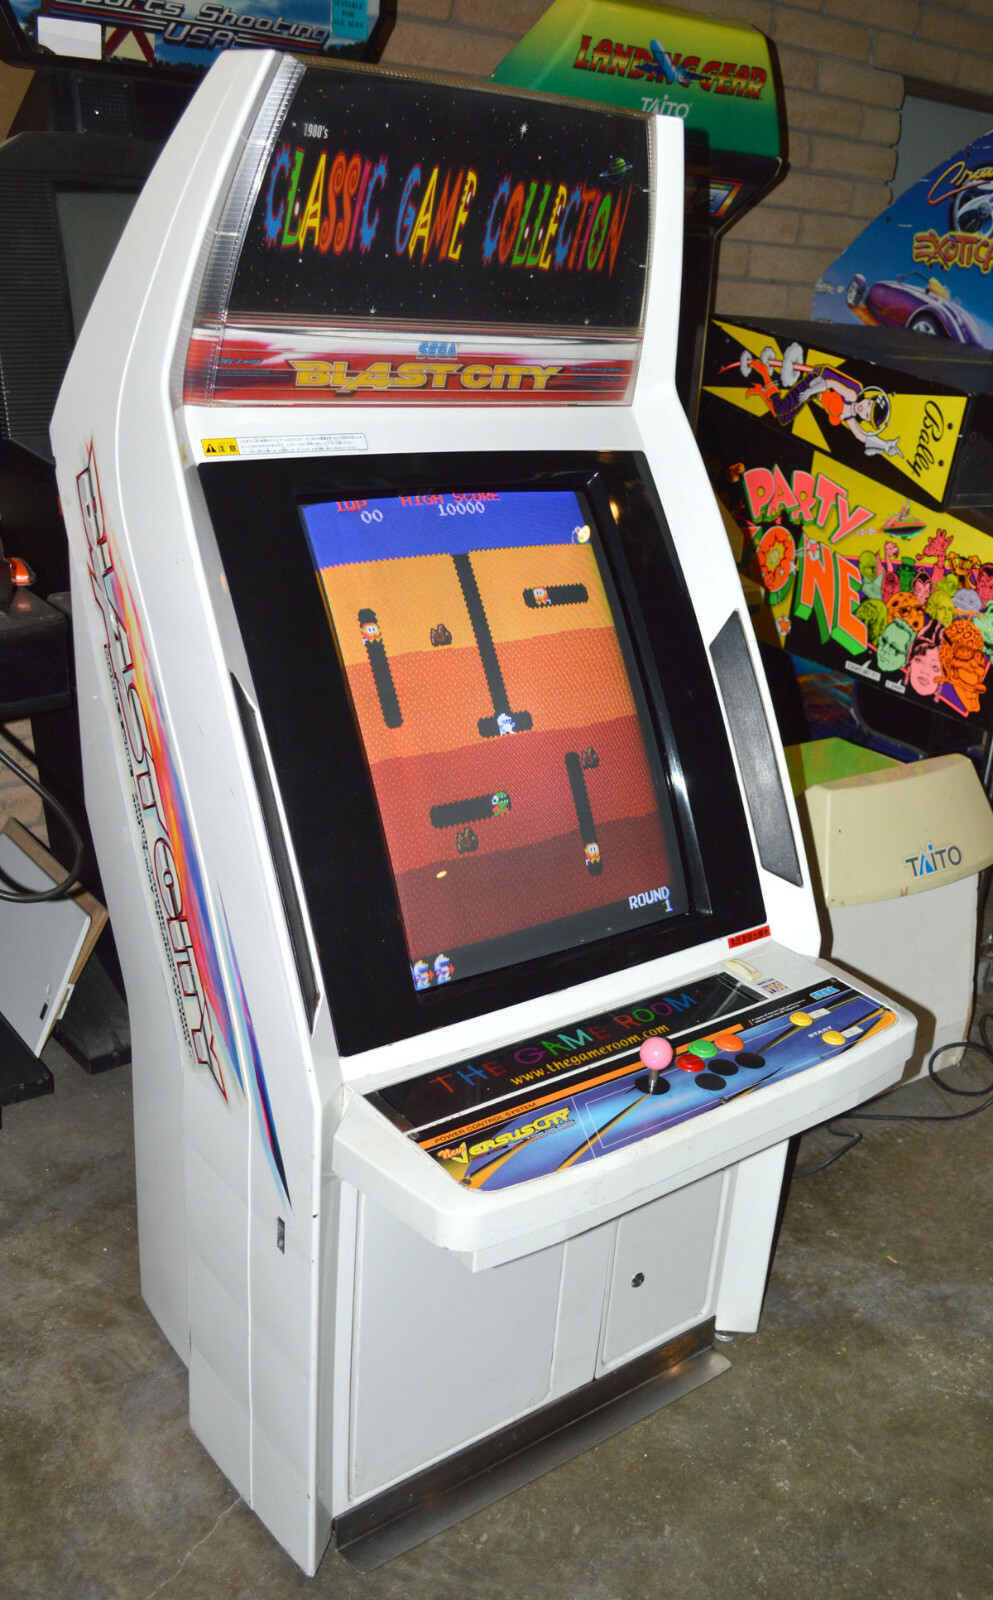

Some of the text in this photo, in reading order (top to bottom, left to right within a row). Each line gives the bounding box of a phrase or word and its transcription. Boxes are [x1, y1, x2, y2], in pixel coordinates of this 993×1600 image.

[163, 22, 236, 49] USA
[196, 3, 329, 44] Shooting
[700, 61, 767, 100] GEAR
[641, 94, 690, 119] TAITO
[303, 122, 329, 139] 1980's
[264, 143, 632, 279] CLASSIC GAME COLLECTION
[416, 341, 457, 359] SEGA
[289, 360, 563, 391] BLAST CITY
[906, 400, 945, 478] Bally
[399, 494, 444, 507] HIGH
[438, 501, 486, 517] 10000
[743, 463, 876, 544] PARTY
[360, 509, 384, 524] 00
[738, 525, 868, 656] ONE
[905, 843, 962, 877] TAITO
[628, 886, 671, 910] ROUND
[664, 899, 674, 913] 1
[429, 993, 697, 1093] THE GAME ROOM
[808, 1025, 833, 1038] START
[510, 1022, 670, 1087] www.thegameroom.com
[434, 1102, 537, 1144] POWER CONTROL SYSTEM
